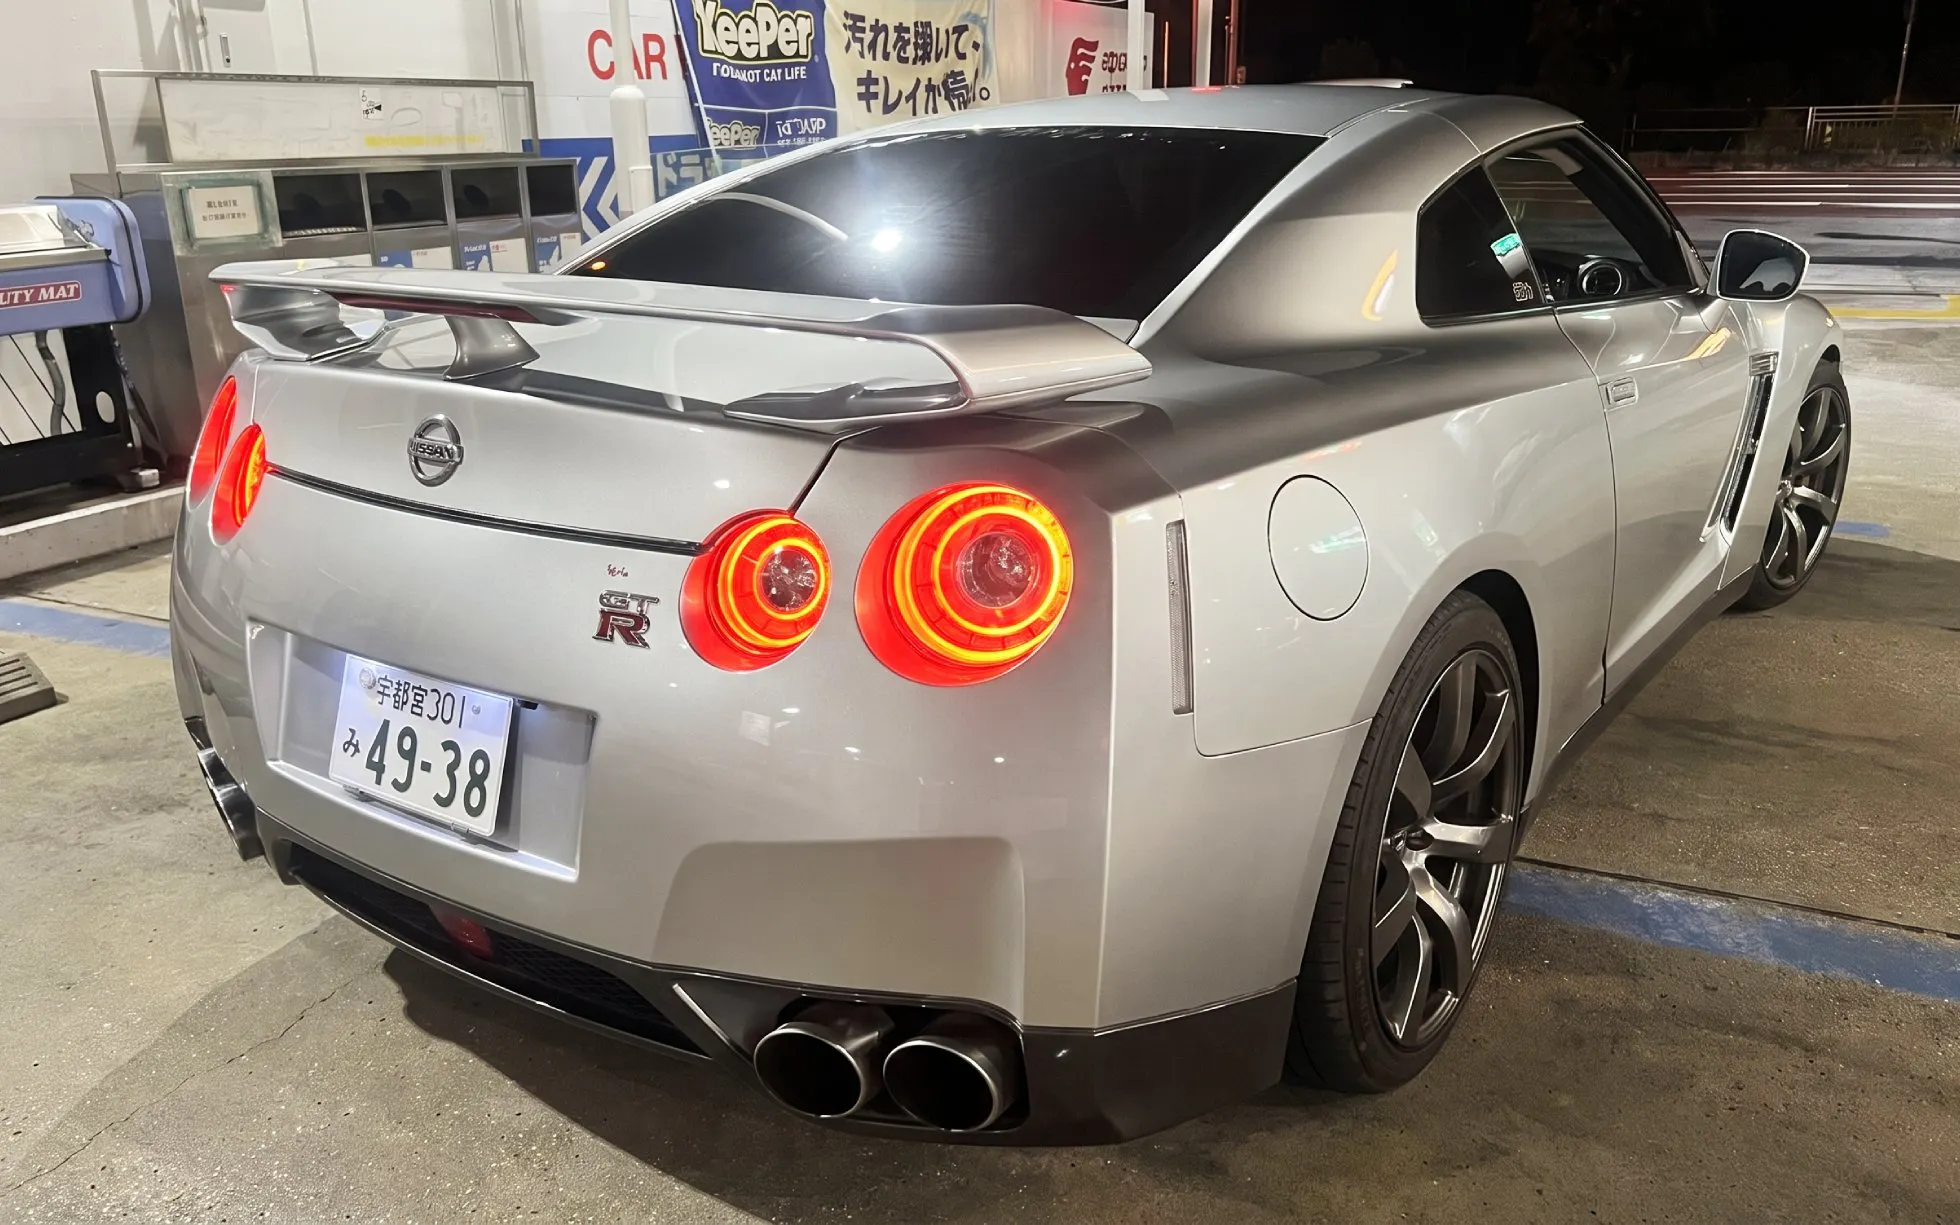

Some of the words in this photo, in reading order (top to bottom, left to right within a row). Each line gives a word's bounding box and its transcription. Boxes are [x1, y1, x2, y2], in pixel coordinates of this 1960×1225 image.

[693, 0, 812, 60] KeePer
[785, 66, 807, 80] LIFE
[705, 121, 760, 147] eePer
[38, 284, 78, 301] MAT
[409, 440, 456, 460] NISSAN
[599, 589, 660, 614] GT
[592, 608, 650, 649] R
[342, 728, 361, 757] み
[365, 718, 490, 818] 49-38
